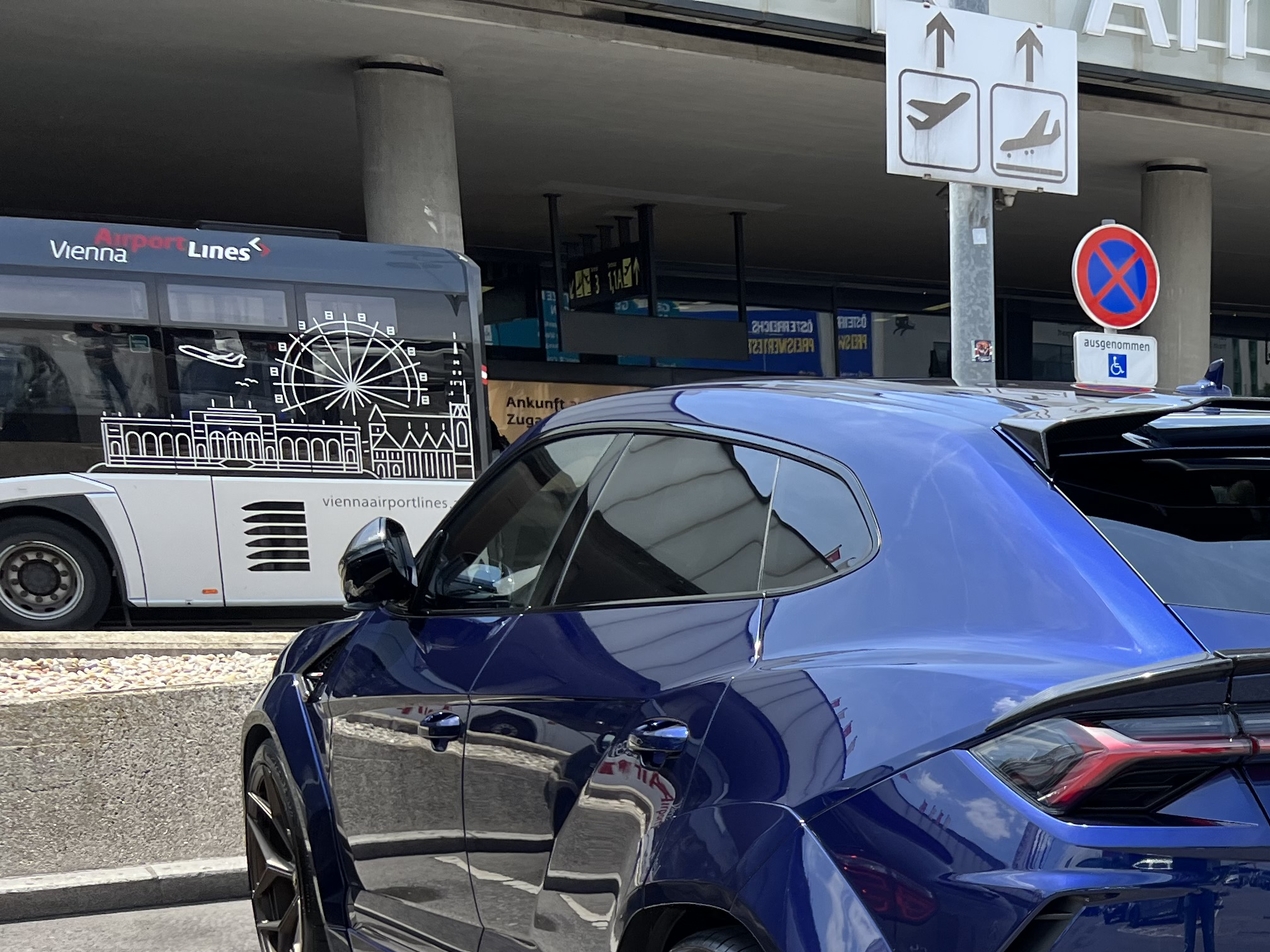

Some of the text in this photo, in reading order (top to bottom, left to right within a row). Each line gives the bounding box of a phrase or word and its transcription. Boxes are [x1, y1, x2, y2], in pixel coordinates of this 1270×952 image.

[50, 227, 250, 263] Vienna Airport Lines
[1084, 338, 1150, 352] ausgenommen
[506, 396, 566, 412] Ankunft
